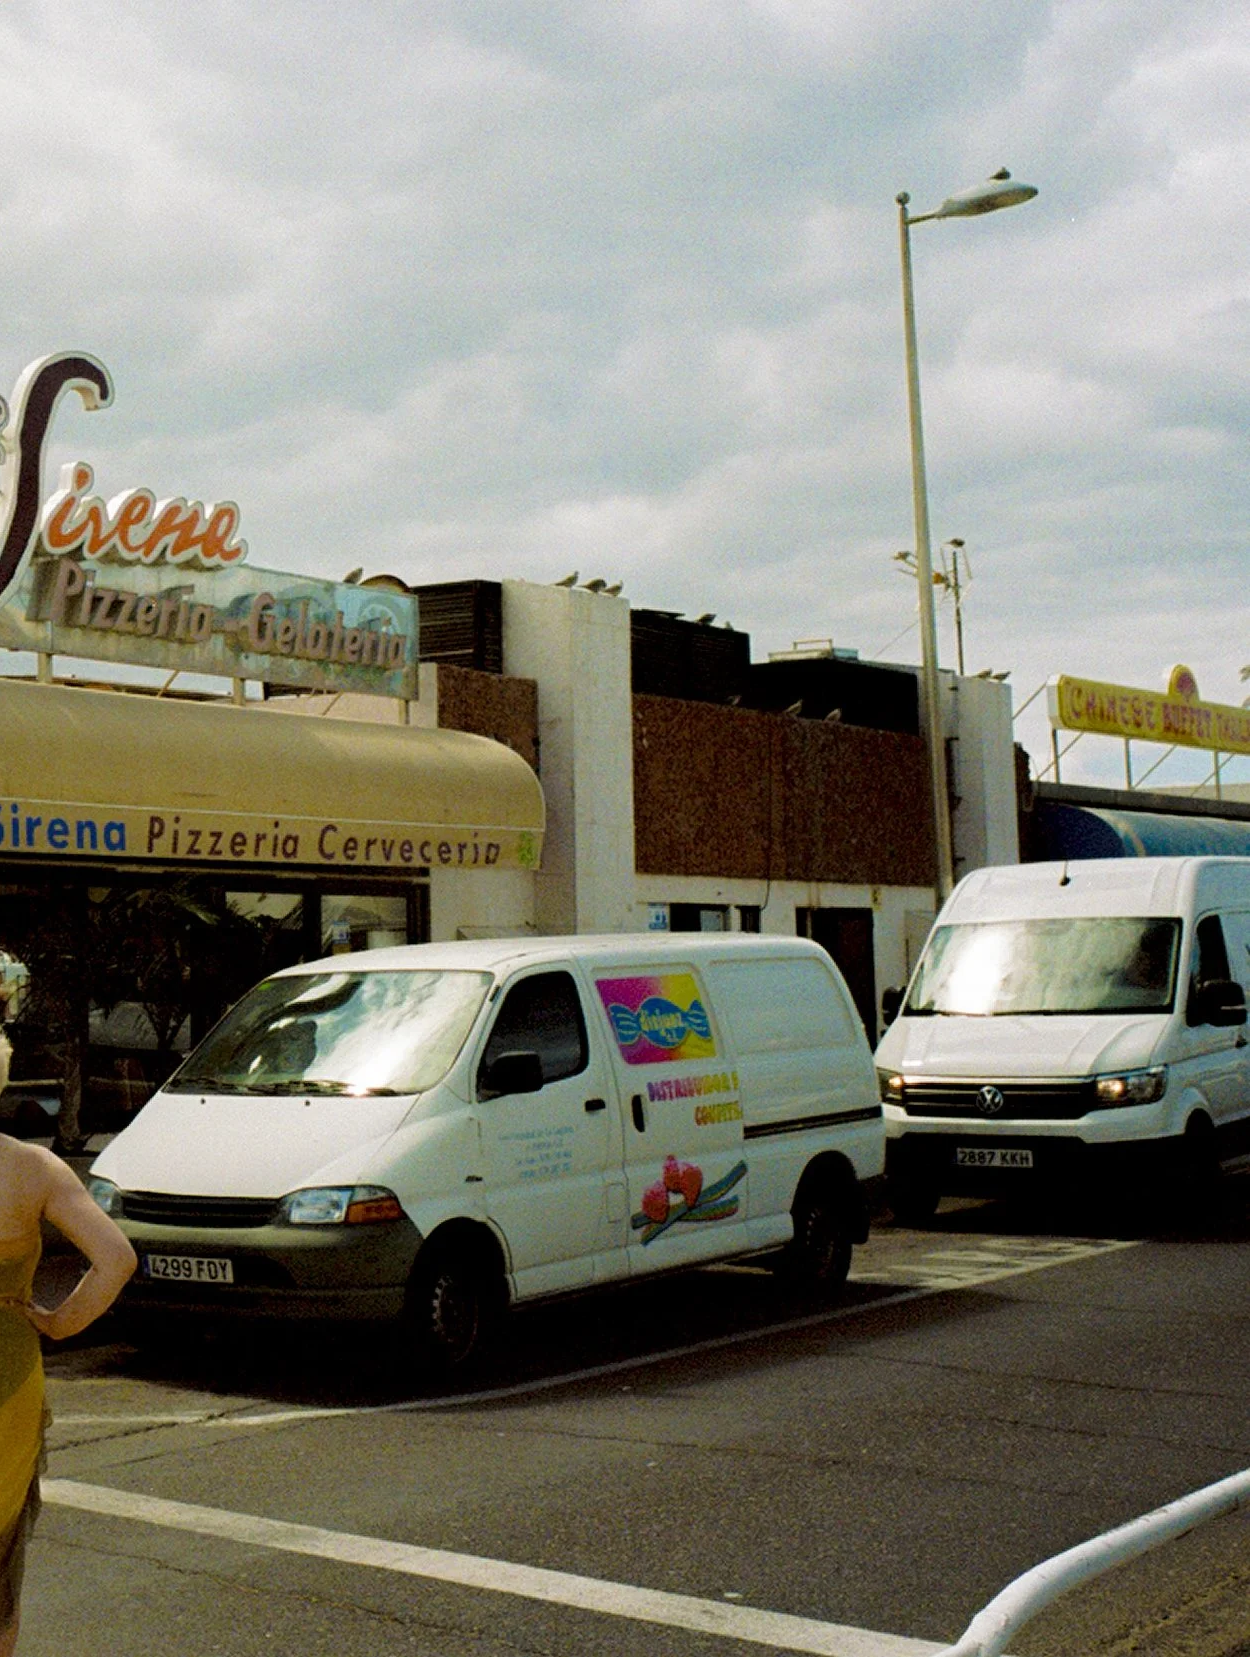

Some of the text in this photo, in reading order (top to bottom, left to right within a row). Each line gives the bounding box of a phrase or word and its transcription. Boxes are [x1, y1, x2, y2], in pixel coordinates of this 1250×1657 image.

[146, 814, 299, 860] Pizzeria
[318, 823, 501, 867] Cerveceria
[1000, 1151, 1030, 1166] KKH
[151, 1257, 227, 1281] 4299 FDY
